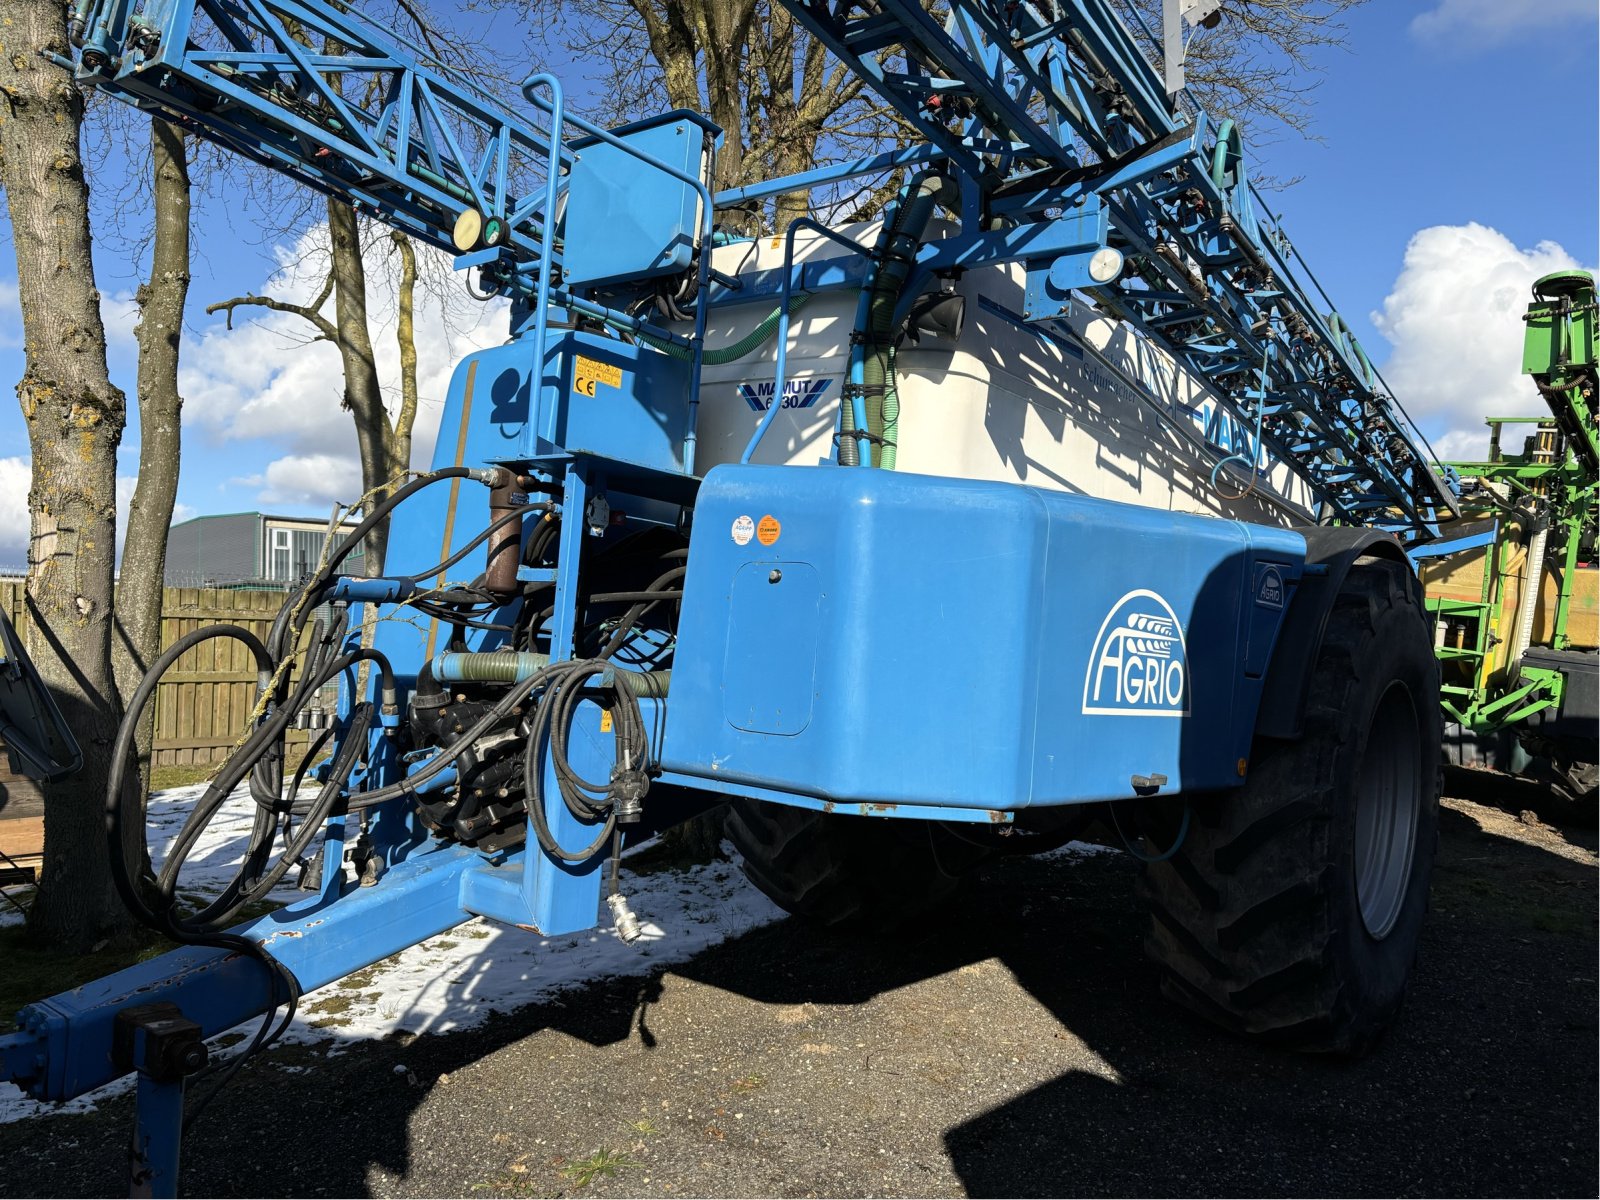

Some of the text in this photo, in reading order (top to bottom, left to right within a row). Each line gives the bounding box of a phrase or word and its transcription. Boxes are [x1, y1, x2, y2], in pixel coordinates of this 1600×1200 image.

[575, 376, 594, 396] CE
[1083, 363, 1136, 404] Schumacher
[765, 395, 799, 410] 630
[1260, 582, 1280, 602] AGRIO
[1093, 626, 1184, 706] AGRIO
